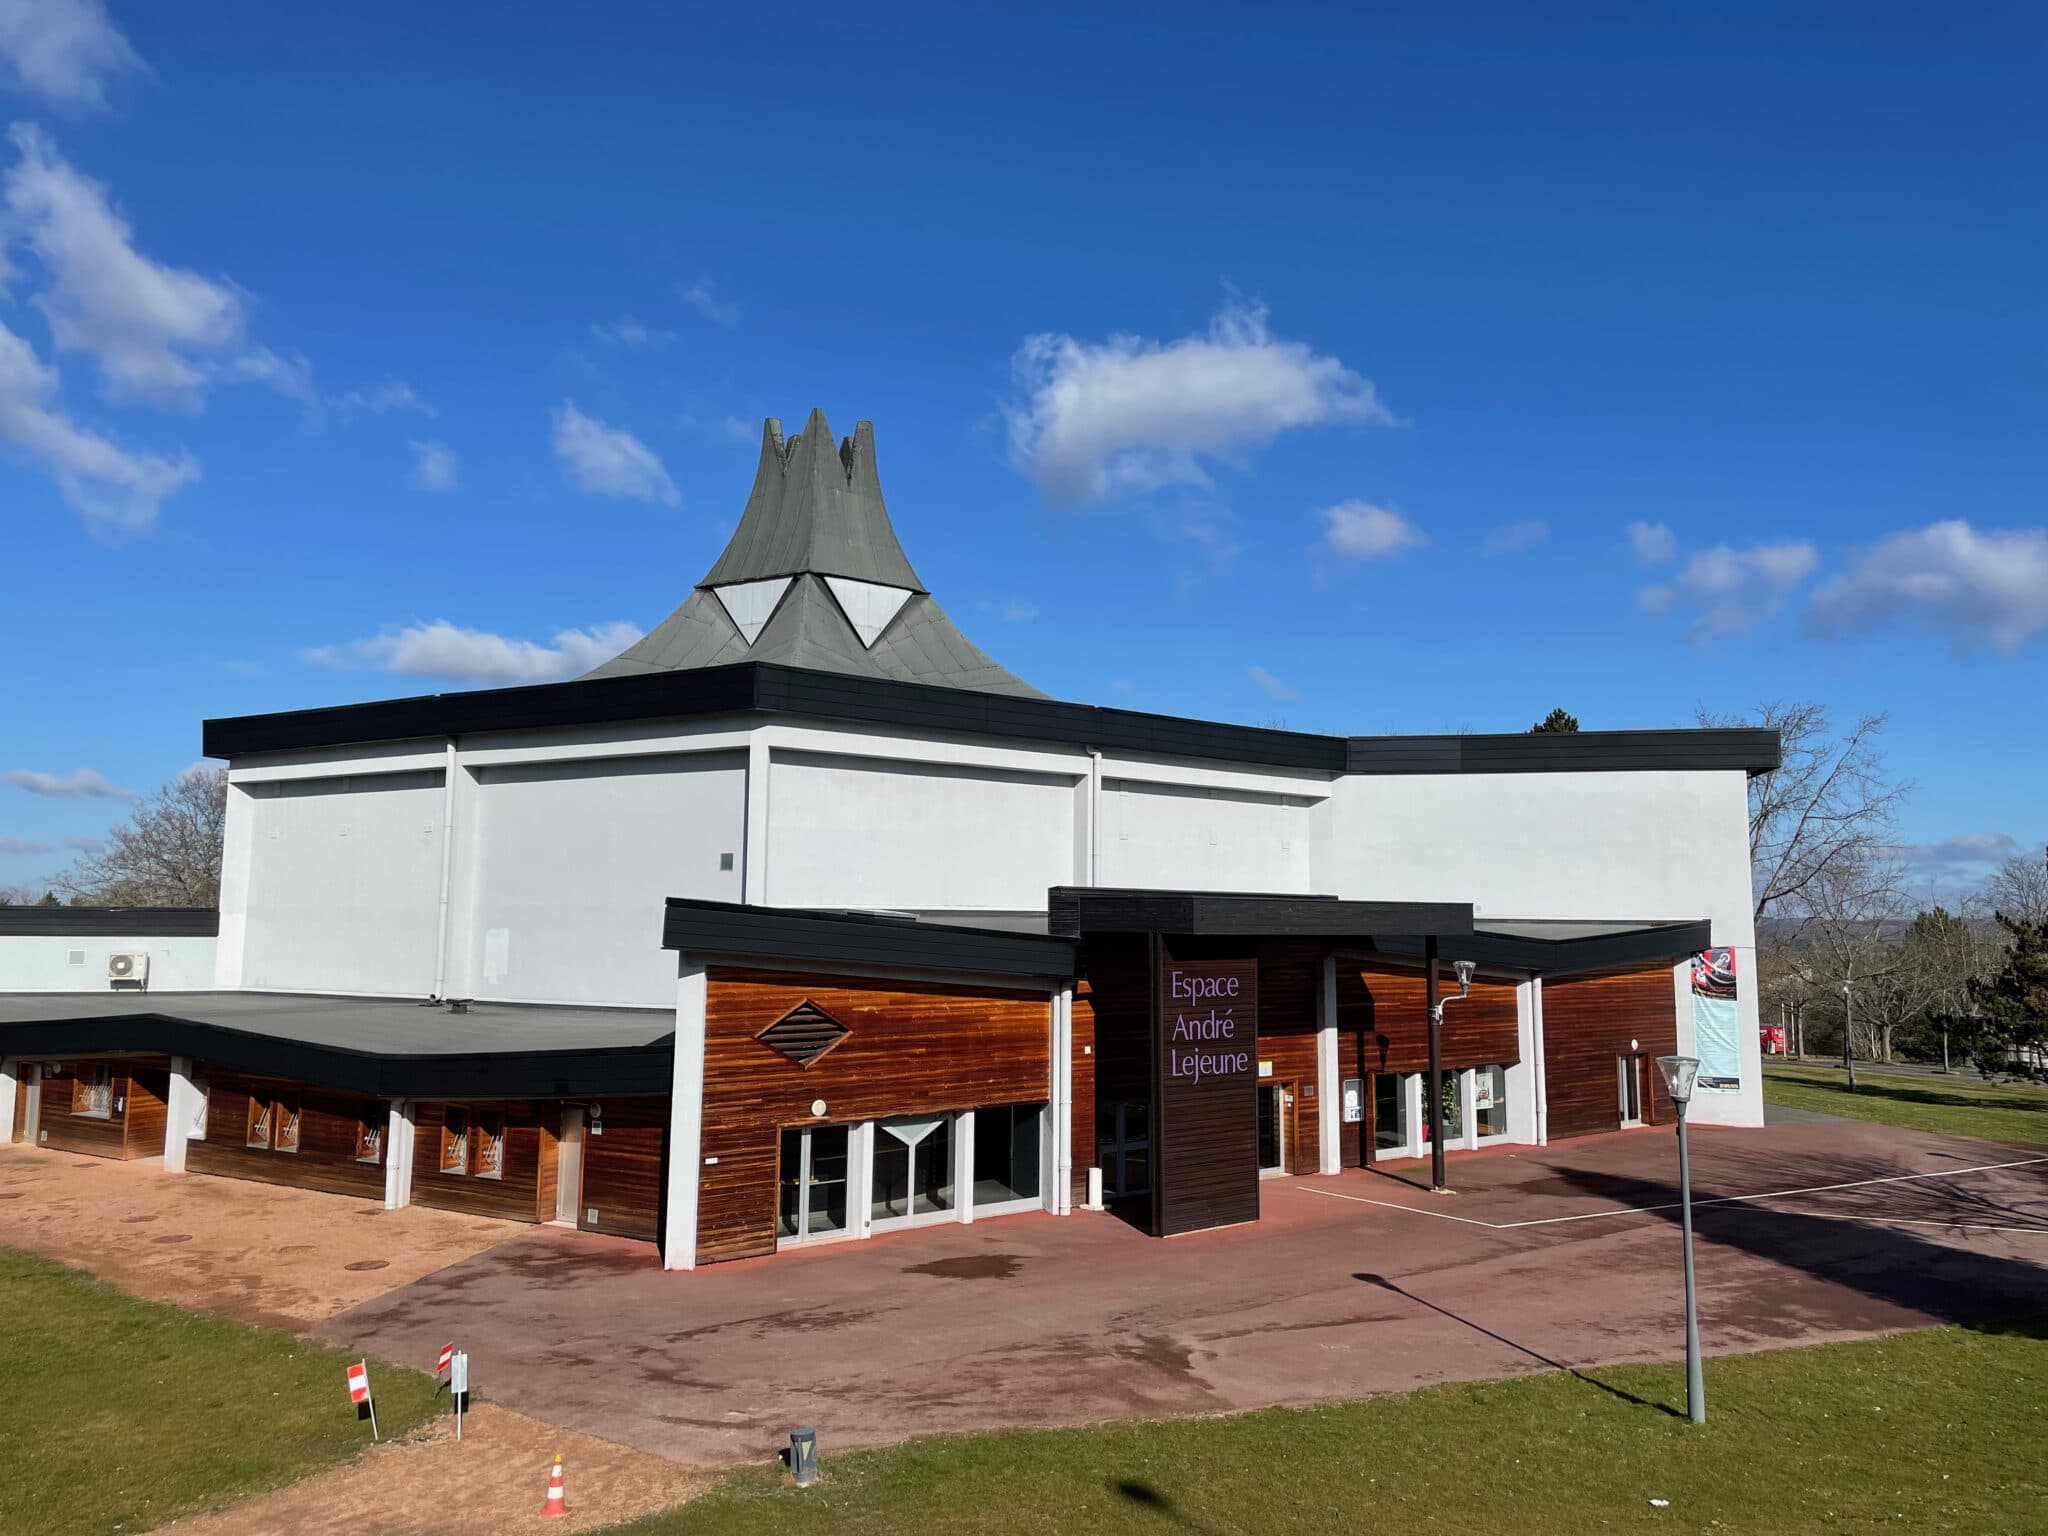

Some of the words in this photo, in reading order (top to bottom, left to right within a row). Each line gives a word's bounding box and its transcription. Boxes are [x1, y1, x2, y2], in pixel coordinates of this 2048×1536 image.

[1172, 971, 1239, 1006] Espace
[1172, 1008, 1235, 1041] André
[1171, 1048, 1248, 1085] Lejeune
